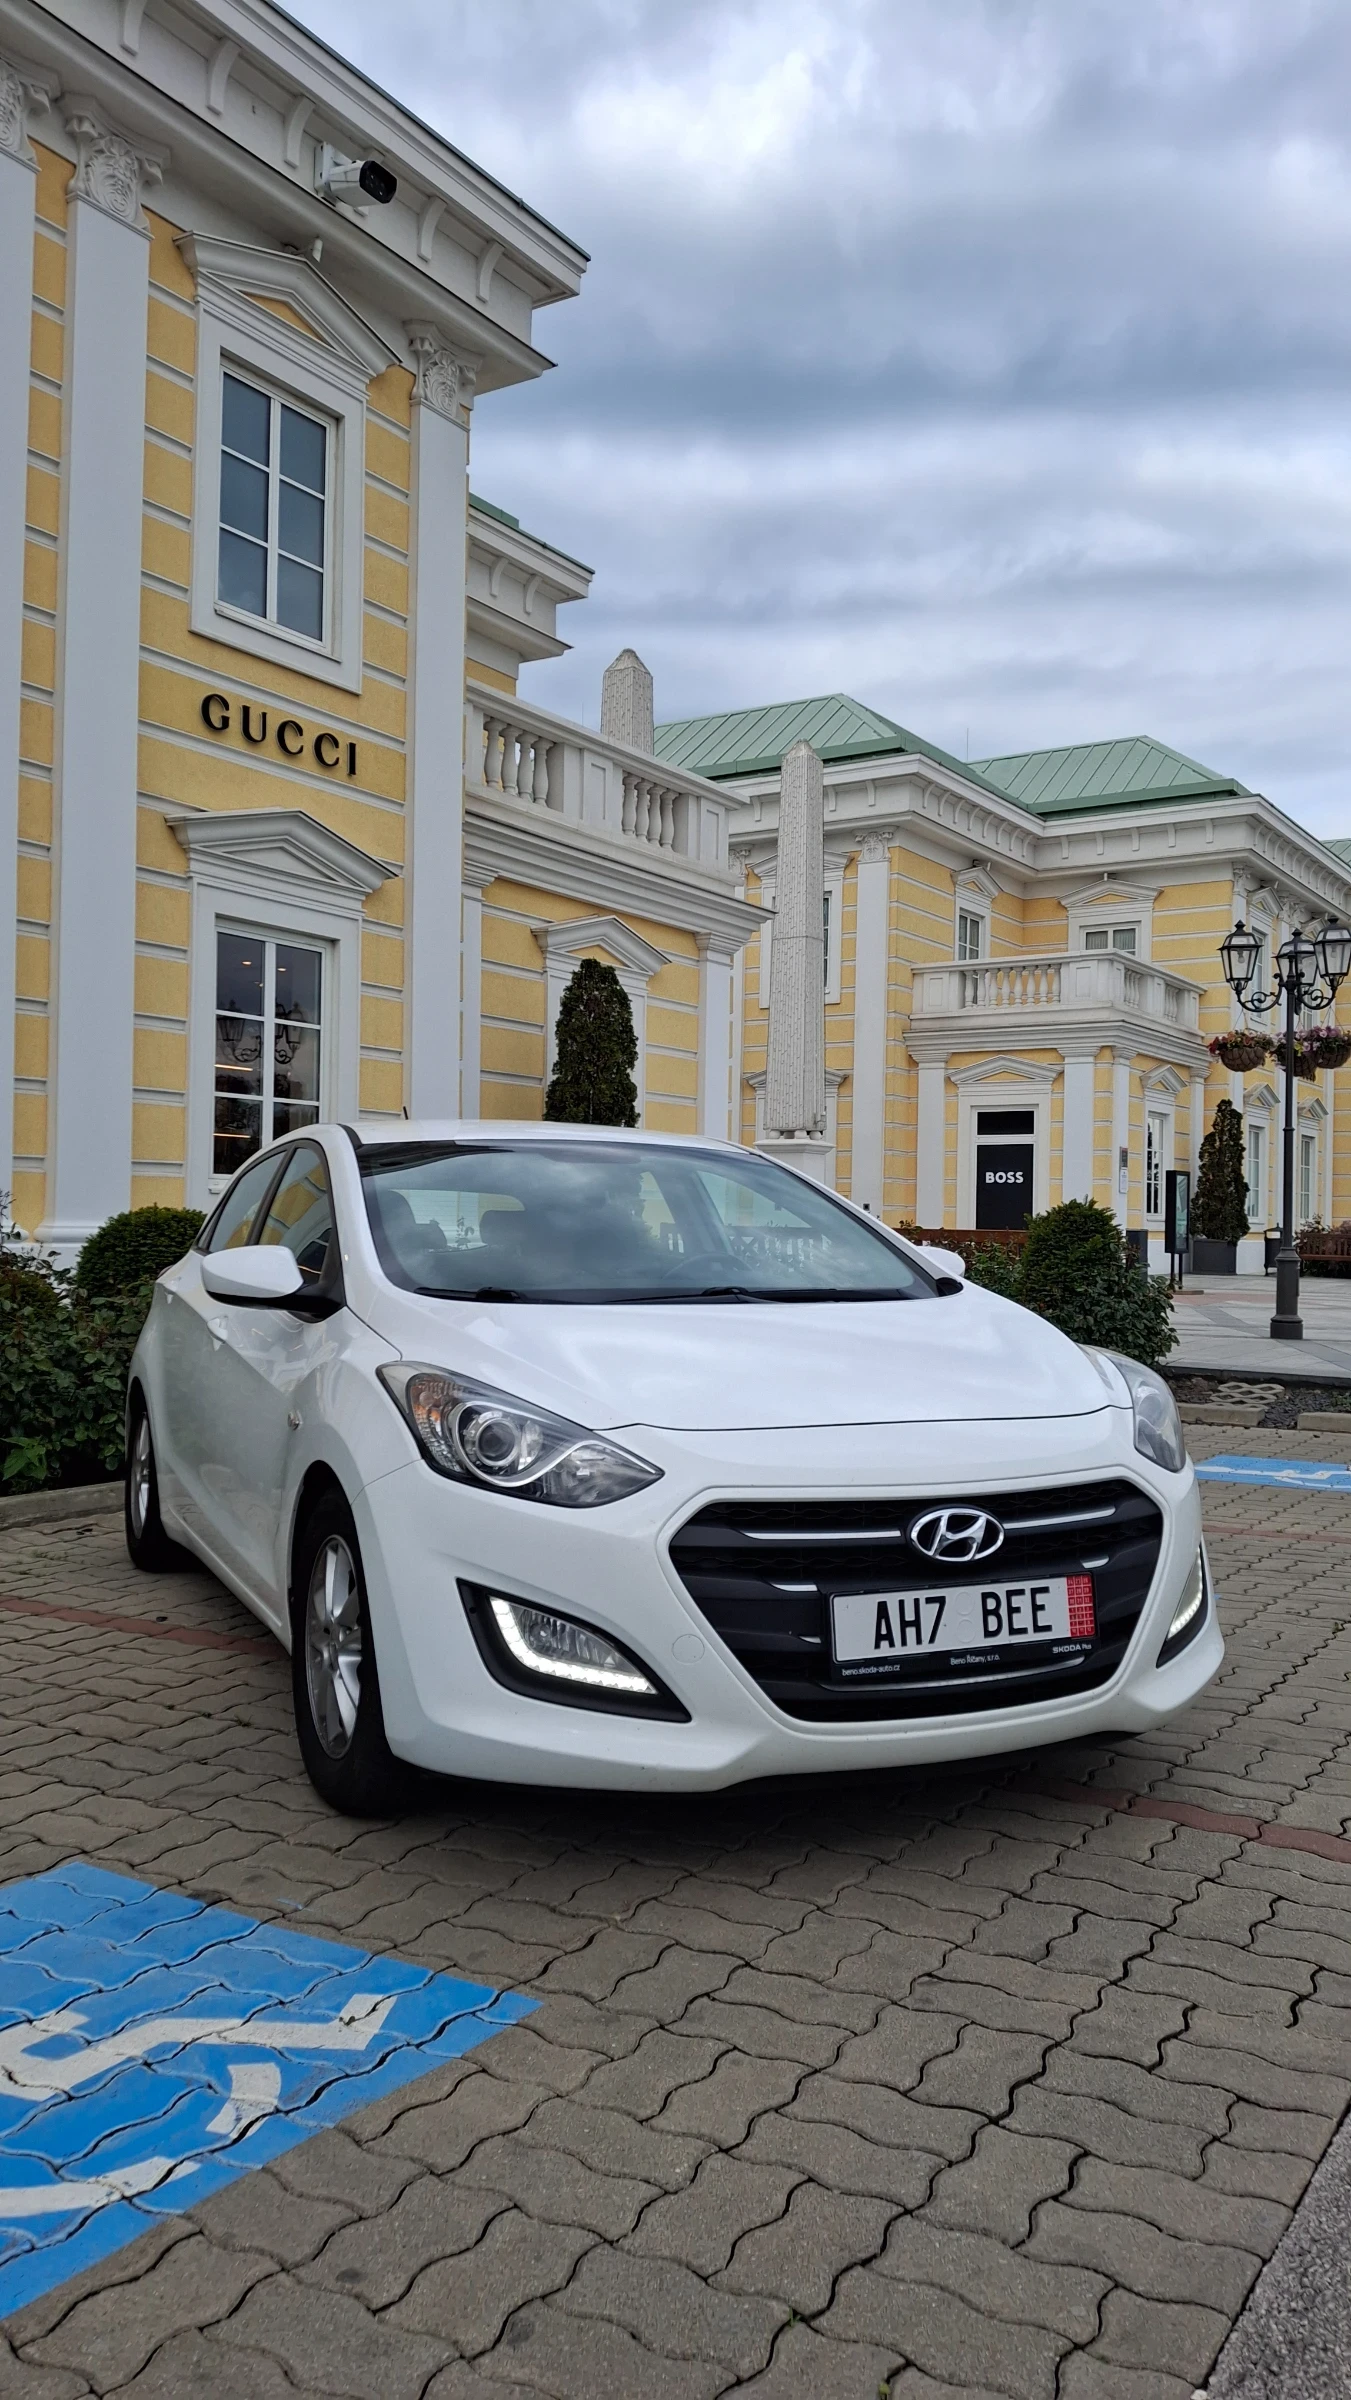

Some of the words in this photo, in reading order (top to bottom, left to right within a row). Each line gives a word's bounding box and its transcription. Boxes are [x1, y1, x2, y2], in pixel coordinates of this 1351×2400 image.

[201, 693, 357, 776] GUCCI
[985, 1171, 1024, 1184] BOSS
[874, 1595, 947, 1650] AH7
[981, 1586, 1053, 1639] BEE
[842, 1664, 901, 1677] beno.skoda-auto.cz
